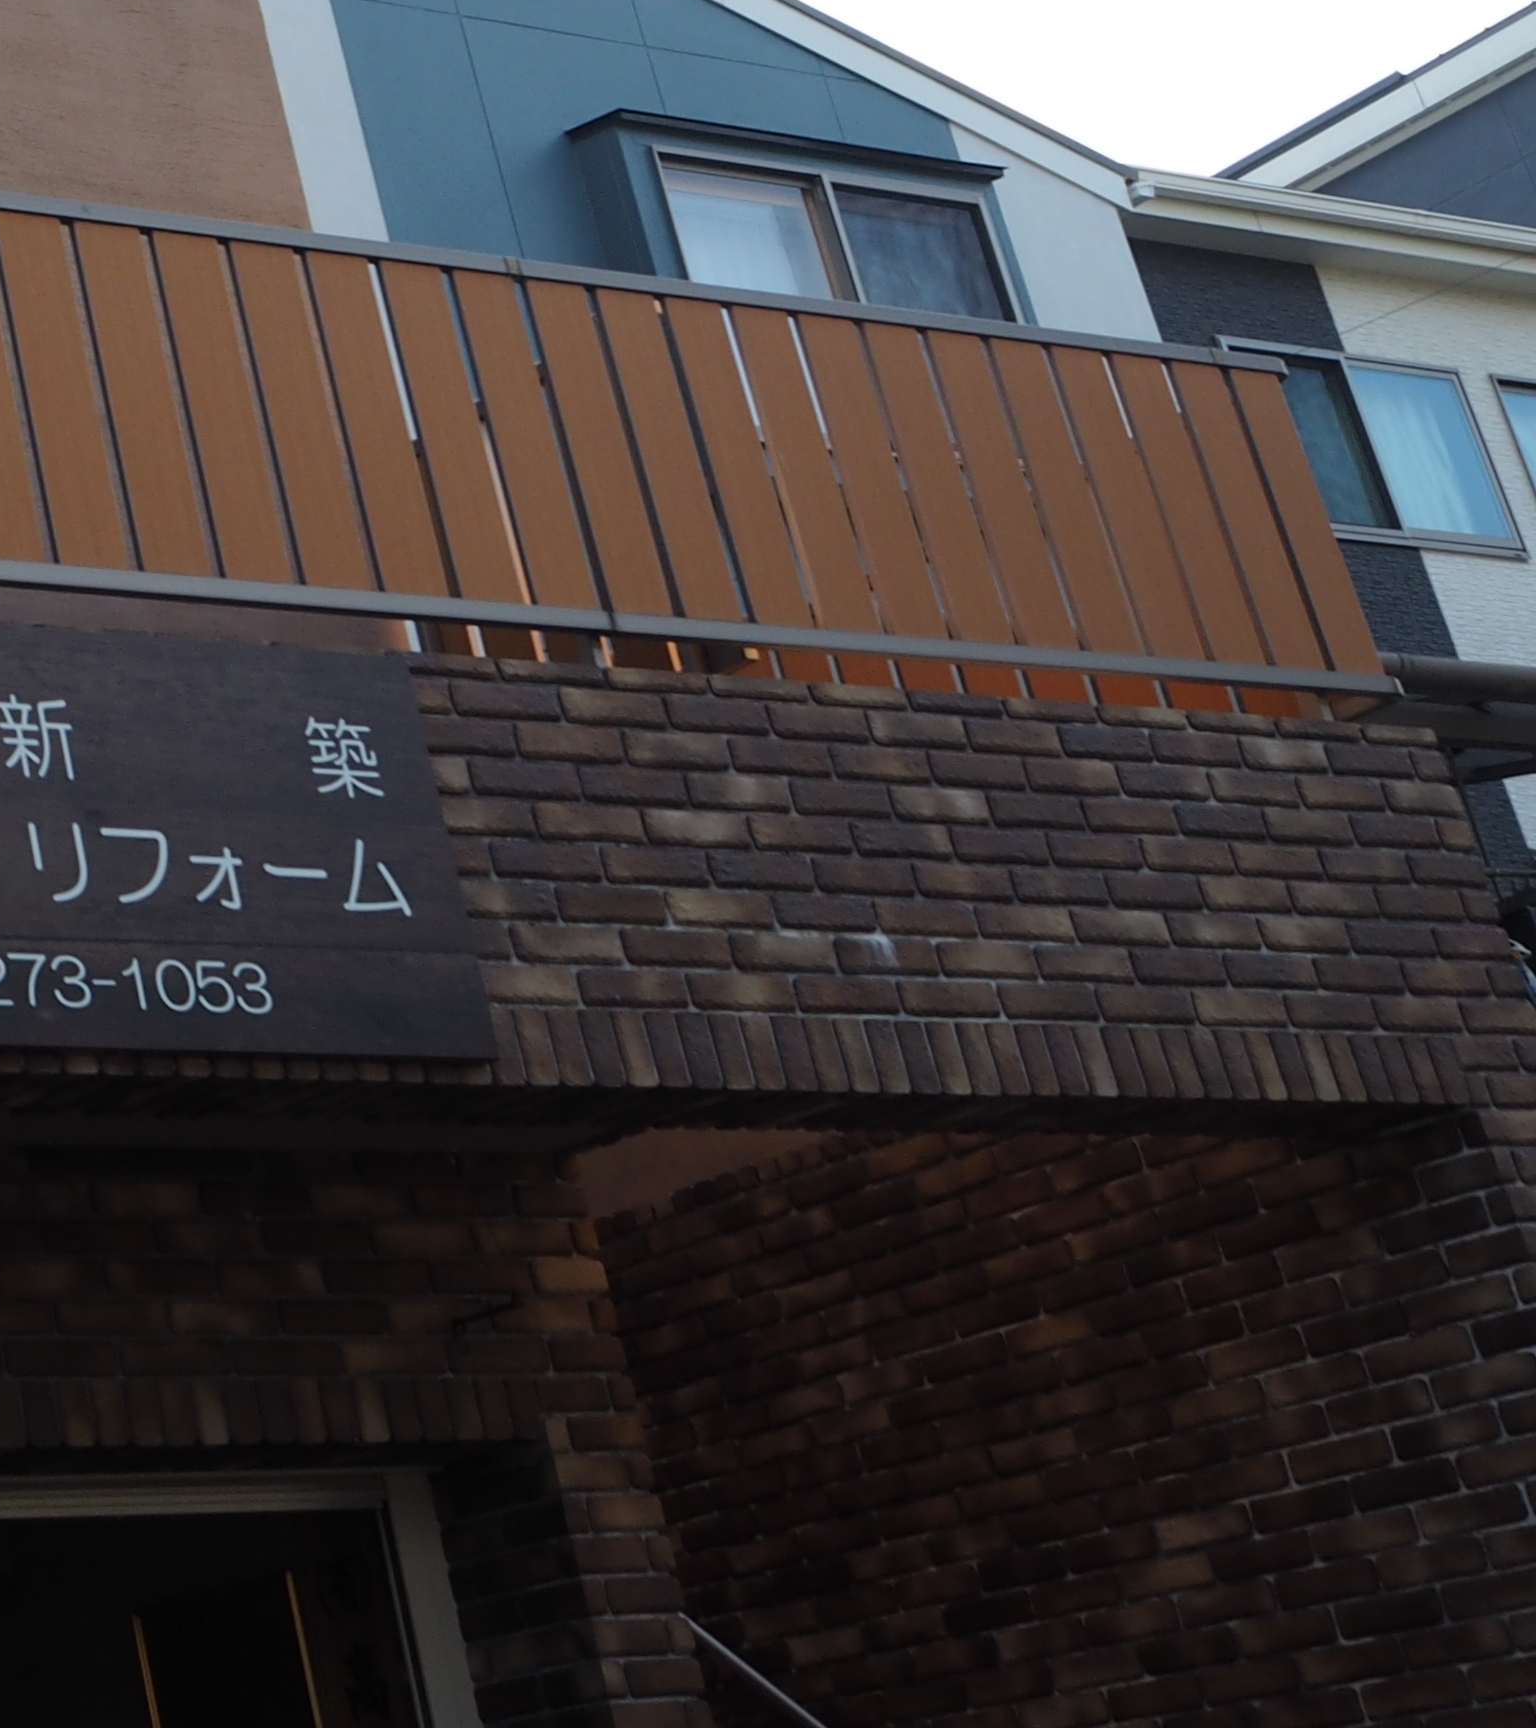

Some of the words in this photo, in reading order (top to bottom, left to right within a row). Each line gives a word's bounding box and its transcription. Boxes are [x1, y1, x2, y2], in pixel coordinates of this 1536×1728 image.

[27, 822, 412, 917] リフォーム
